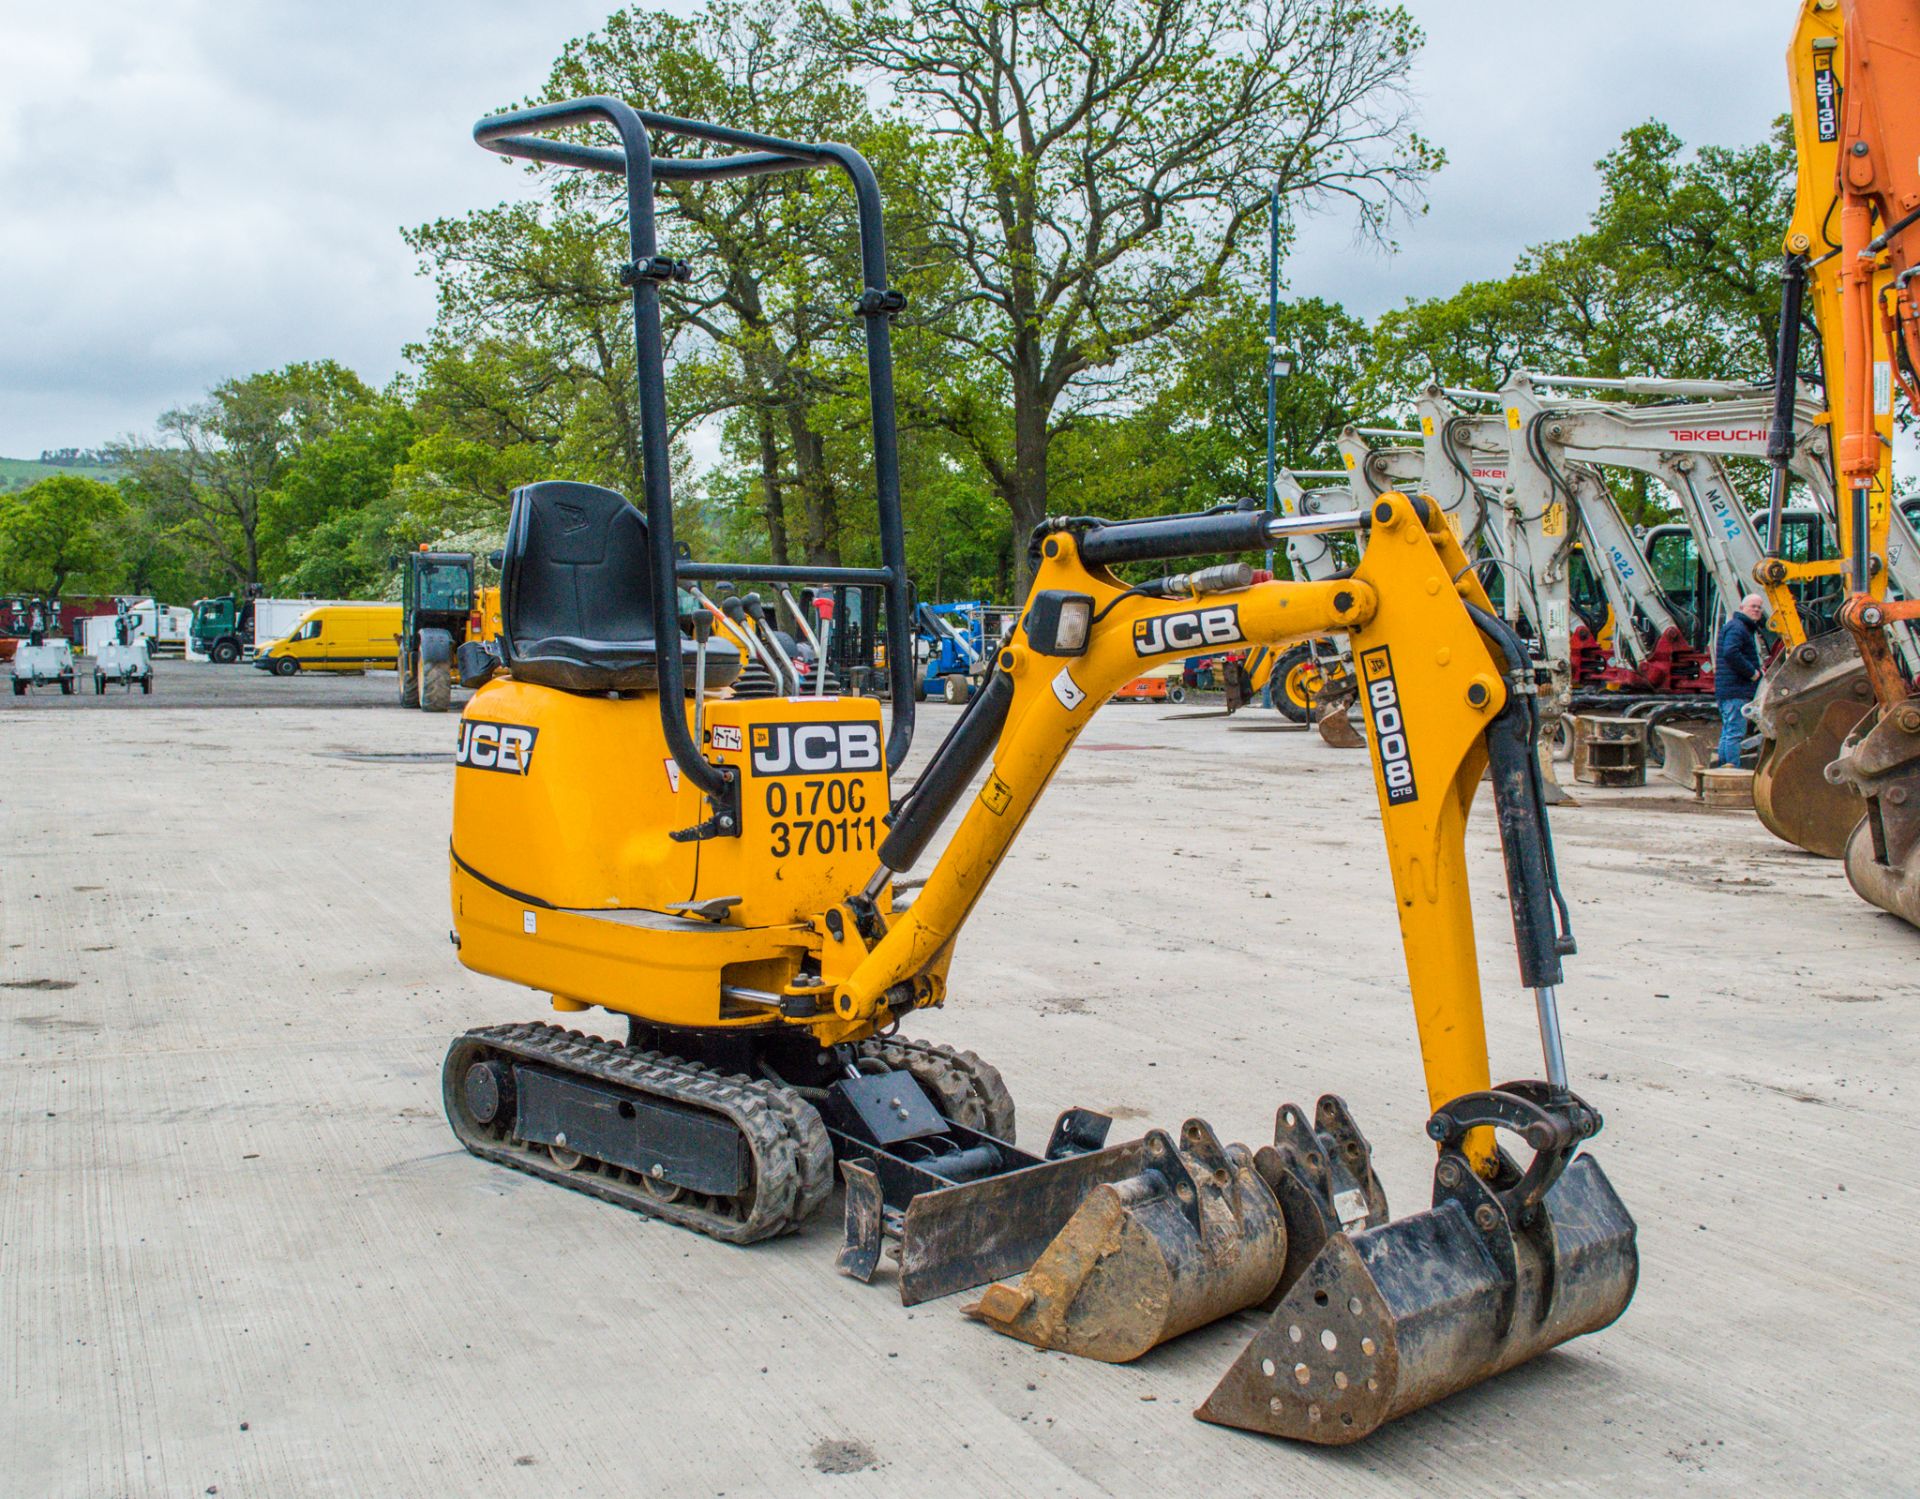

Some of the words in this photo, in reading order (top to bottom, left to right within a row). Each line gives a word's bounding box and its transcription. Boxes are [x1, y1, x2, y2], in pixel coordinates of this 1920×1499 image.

[1817, 70, 1835, 134] JS130
[1705, 489, 1740, 539] M2142
[1136, 609, 1240, 653] JCB
[457, 722, 532, 770] JCB
[755, 725, 879, 772] JCB
[1370, 680, 1412, 788] 8008
[1391, 787, 1412, 797] CTS
[771, 816, 875, 857] 370111
